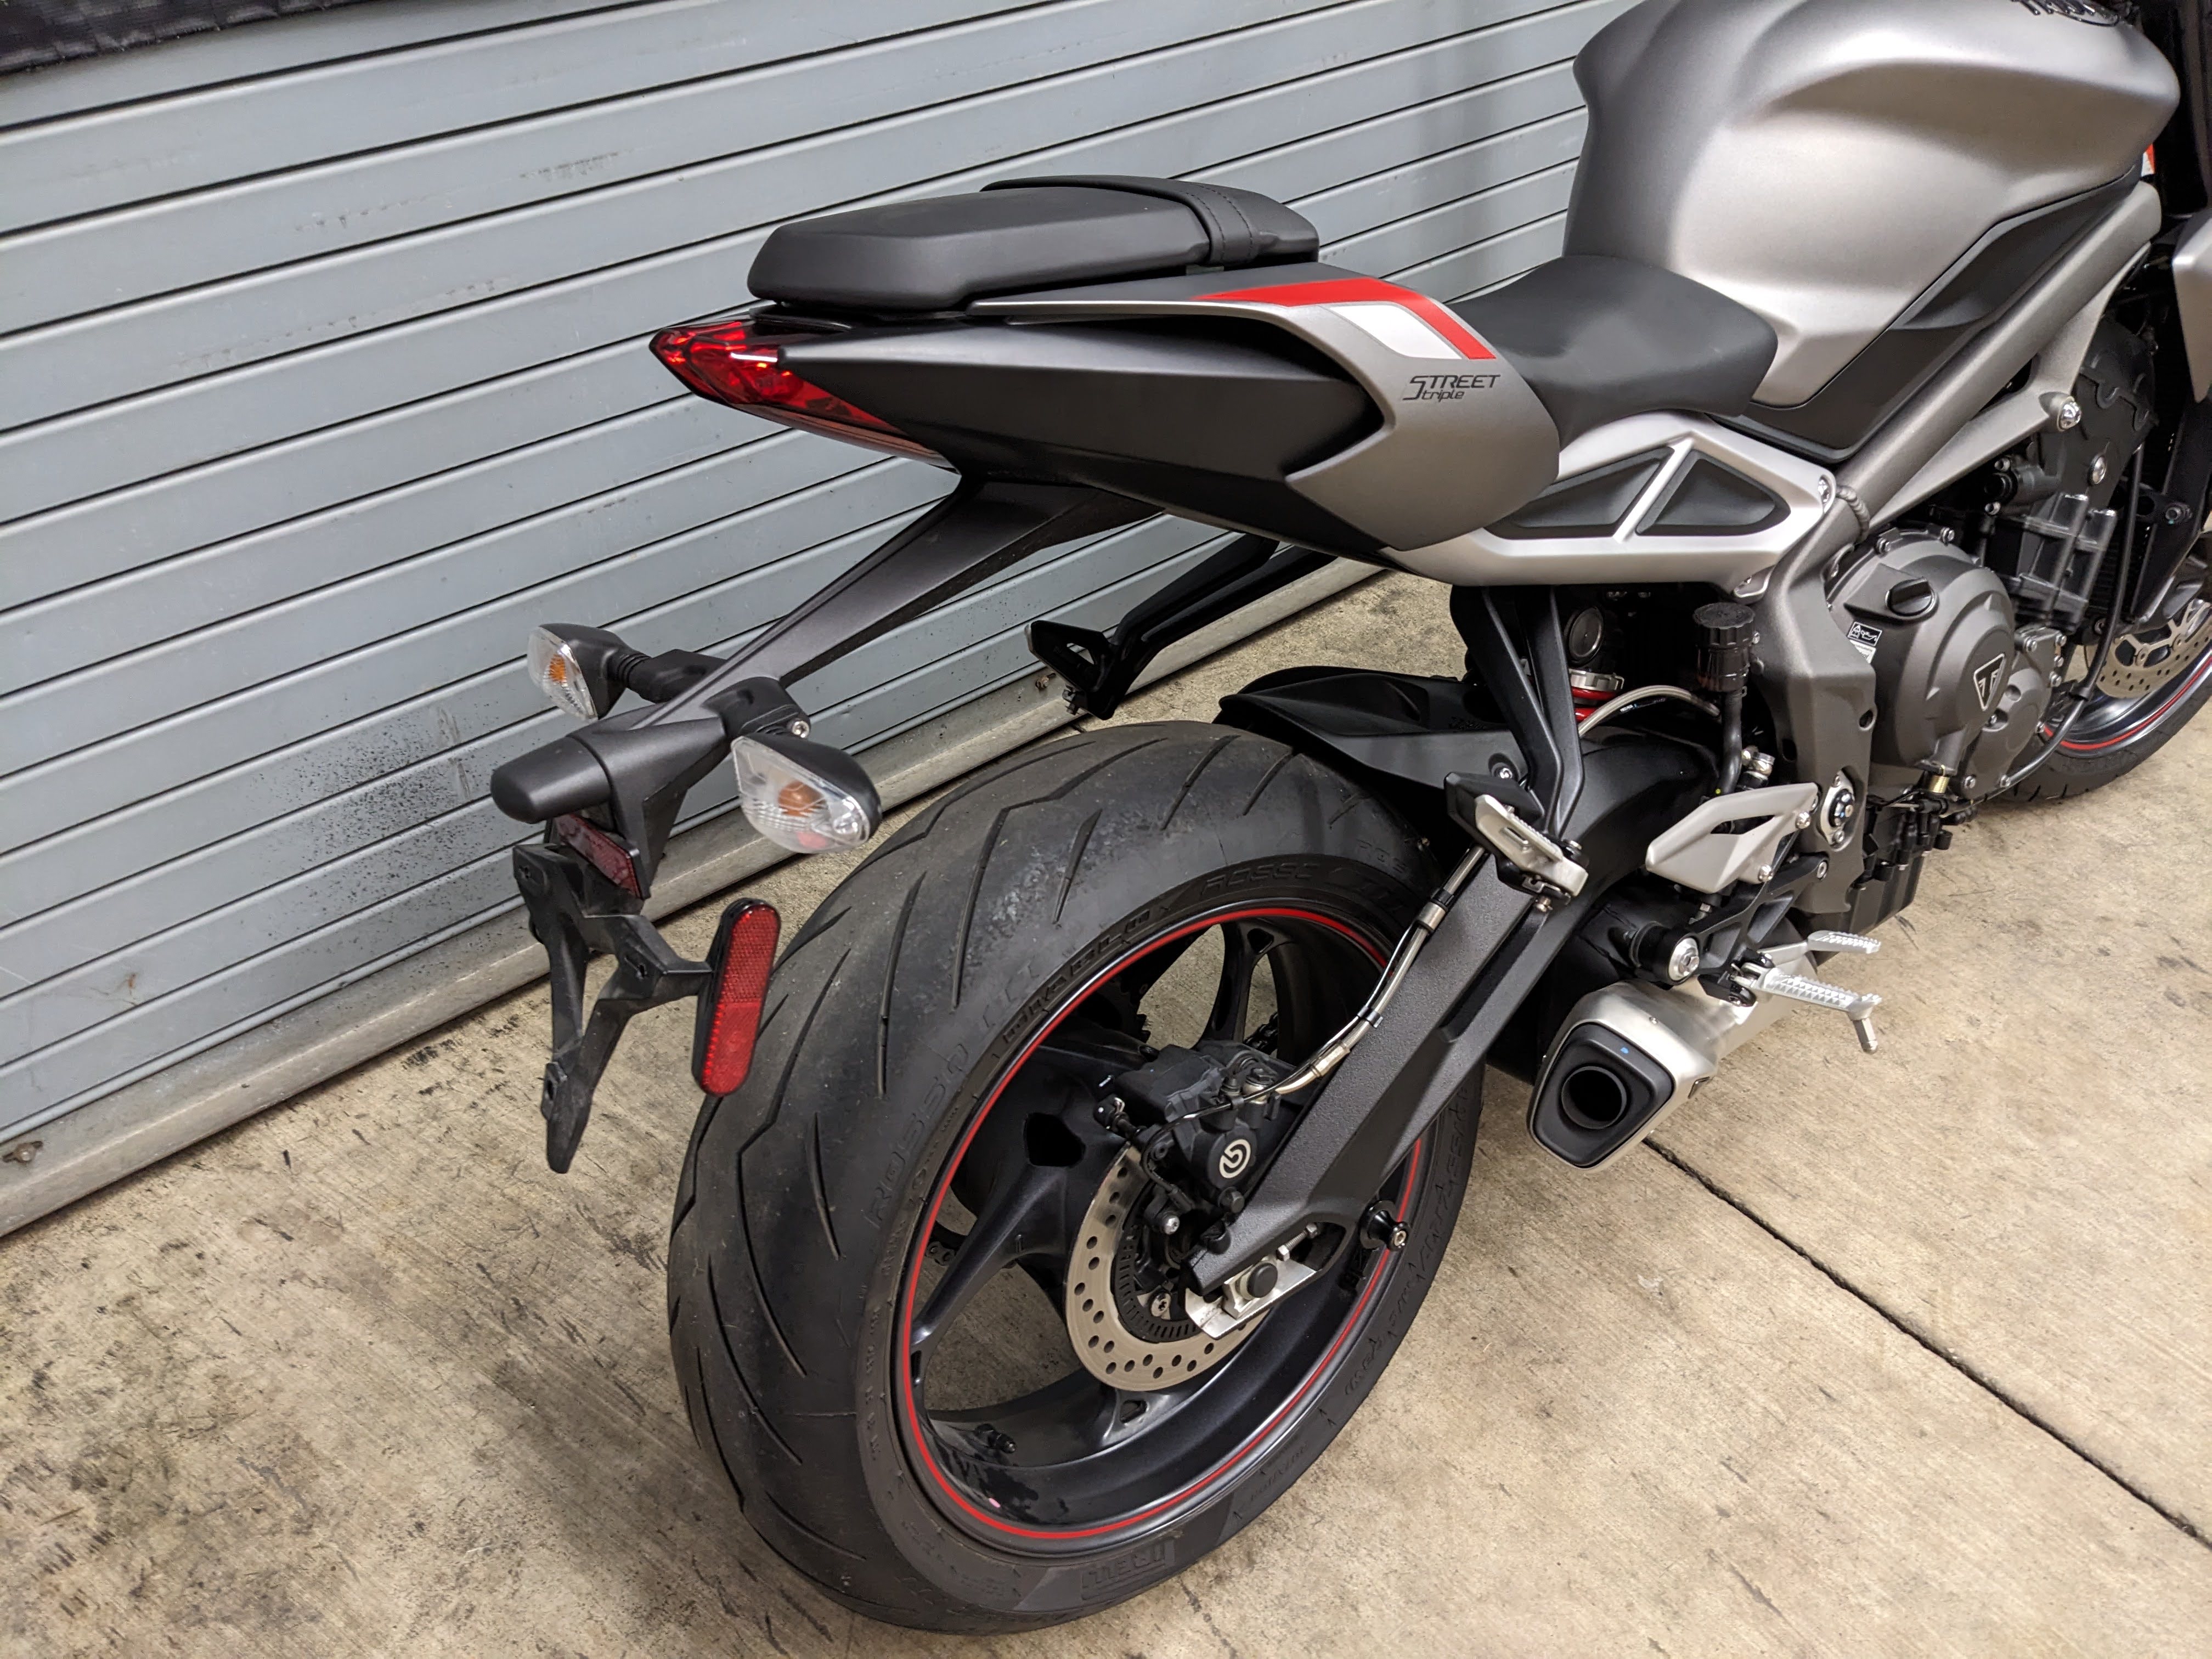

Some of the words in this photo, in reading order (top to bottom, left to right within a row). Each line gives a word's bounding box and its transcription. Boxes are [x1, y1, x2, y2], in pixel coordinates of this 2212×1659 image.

[1403, 374, 1501, 400] STREET
[1003, 909, 1150, 1043] DIABLO
[1201, 862, 1319, 895] ROSSO
